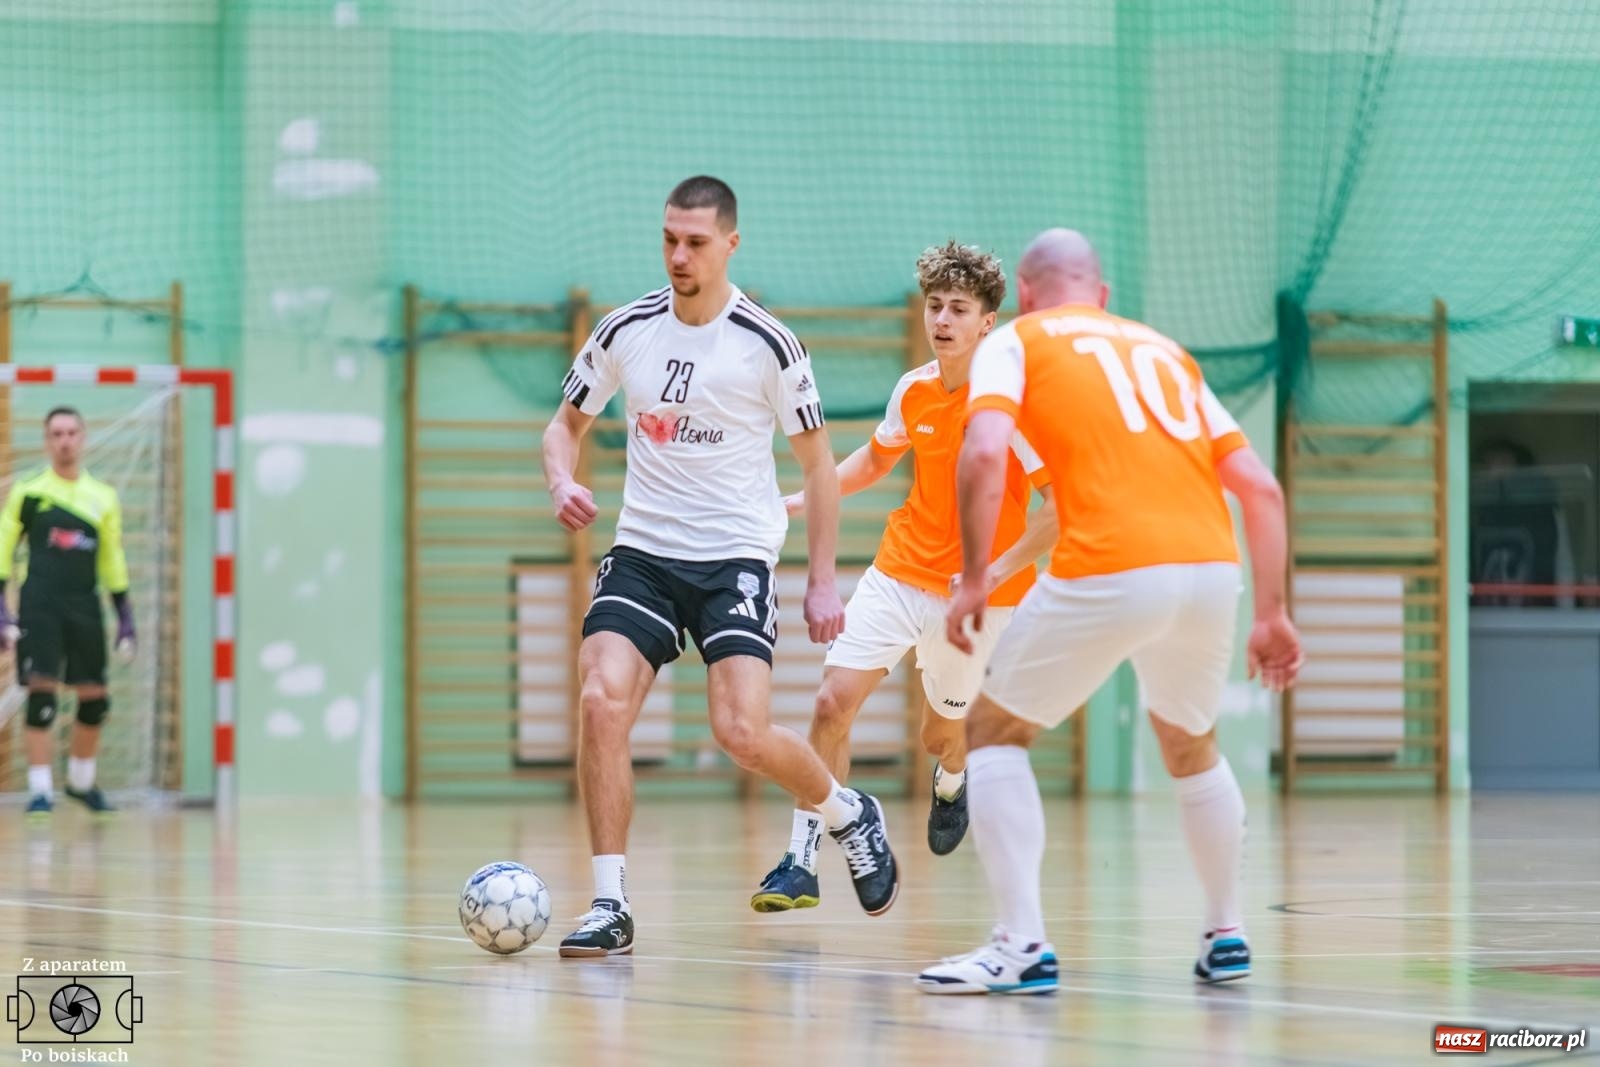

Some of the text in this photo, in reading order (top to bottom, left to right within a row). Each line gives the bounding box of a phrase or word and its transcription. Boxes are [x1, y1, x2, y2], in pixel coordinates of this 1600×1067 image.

[660, 359, 695, 404] 23
[1072, 336, 1201, 441] 10
[943, 698, 967, 708] JAKO
